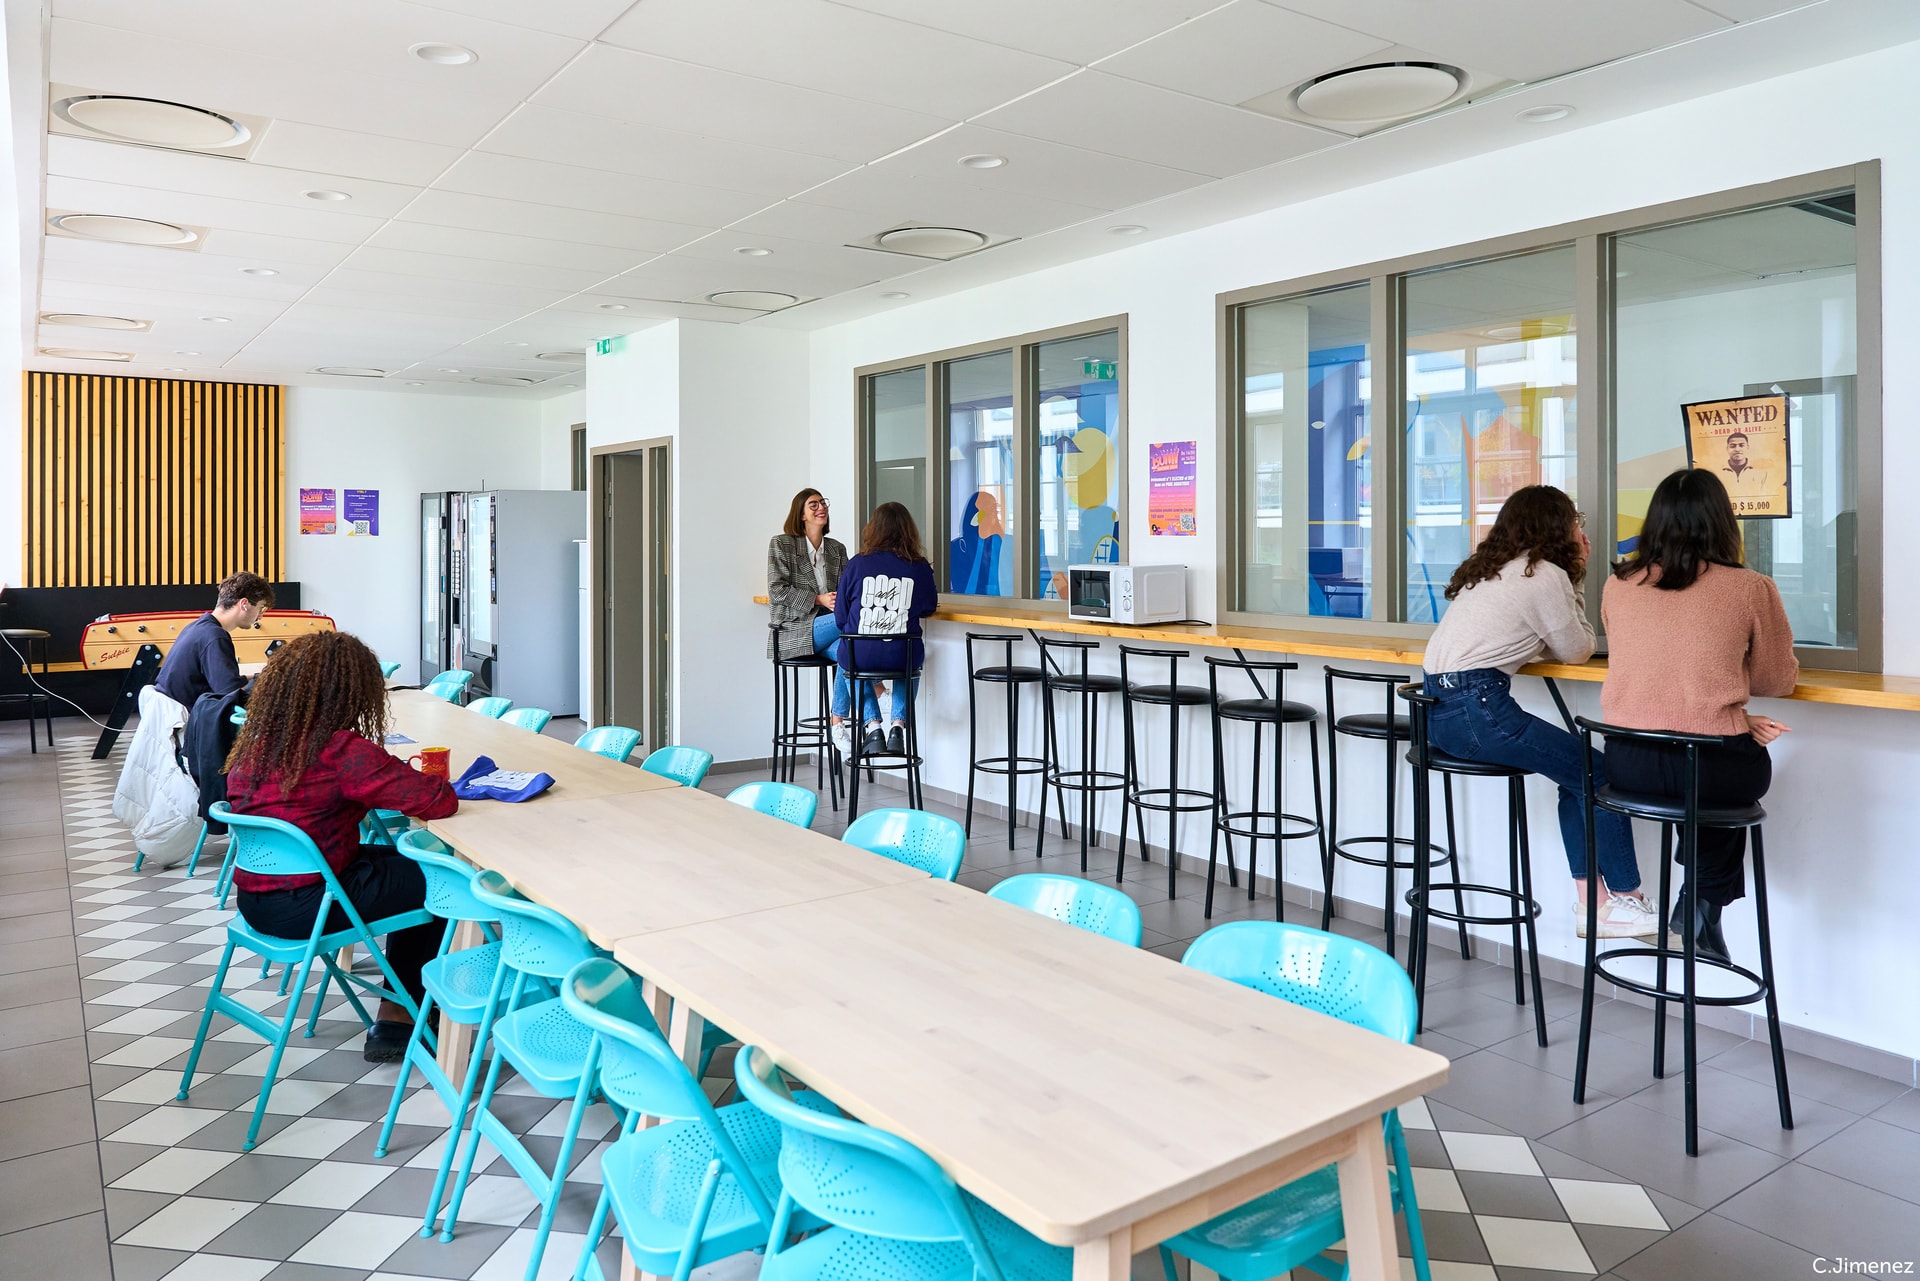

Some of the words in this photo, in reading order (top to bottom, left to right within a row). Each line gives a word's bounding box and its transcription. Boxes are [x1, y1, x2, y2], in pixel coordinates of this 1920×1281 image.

[1696, 404, 1778, 426] WANTED
[1714, 427, 1731, 435] DEAD
[1740, 501, 1745, 510] $
[1747, 501, 1770, 510] 15,000
[861, 574, 914, 610] GOOD
